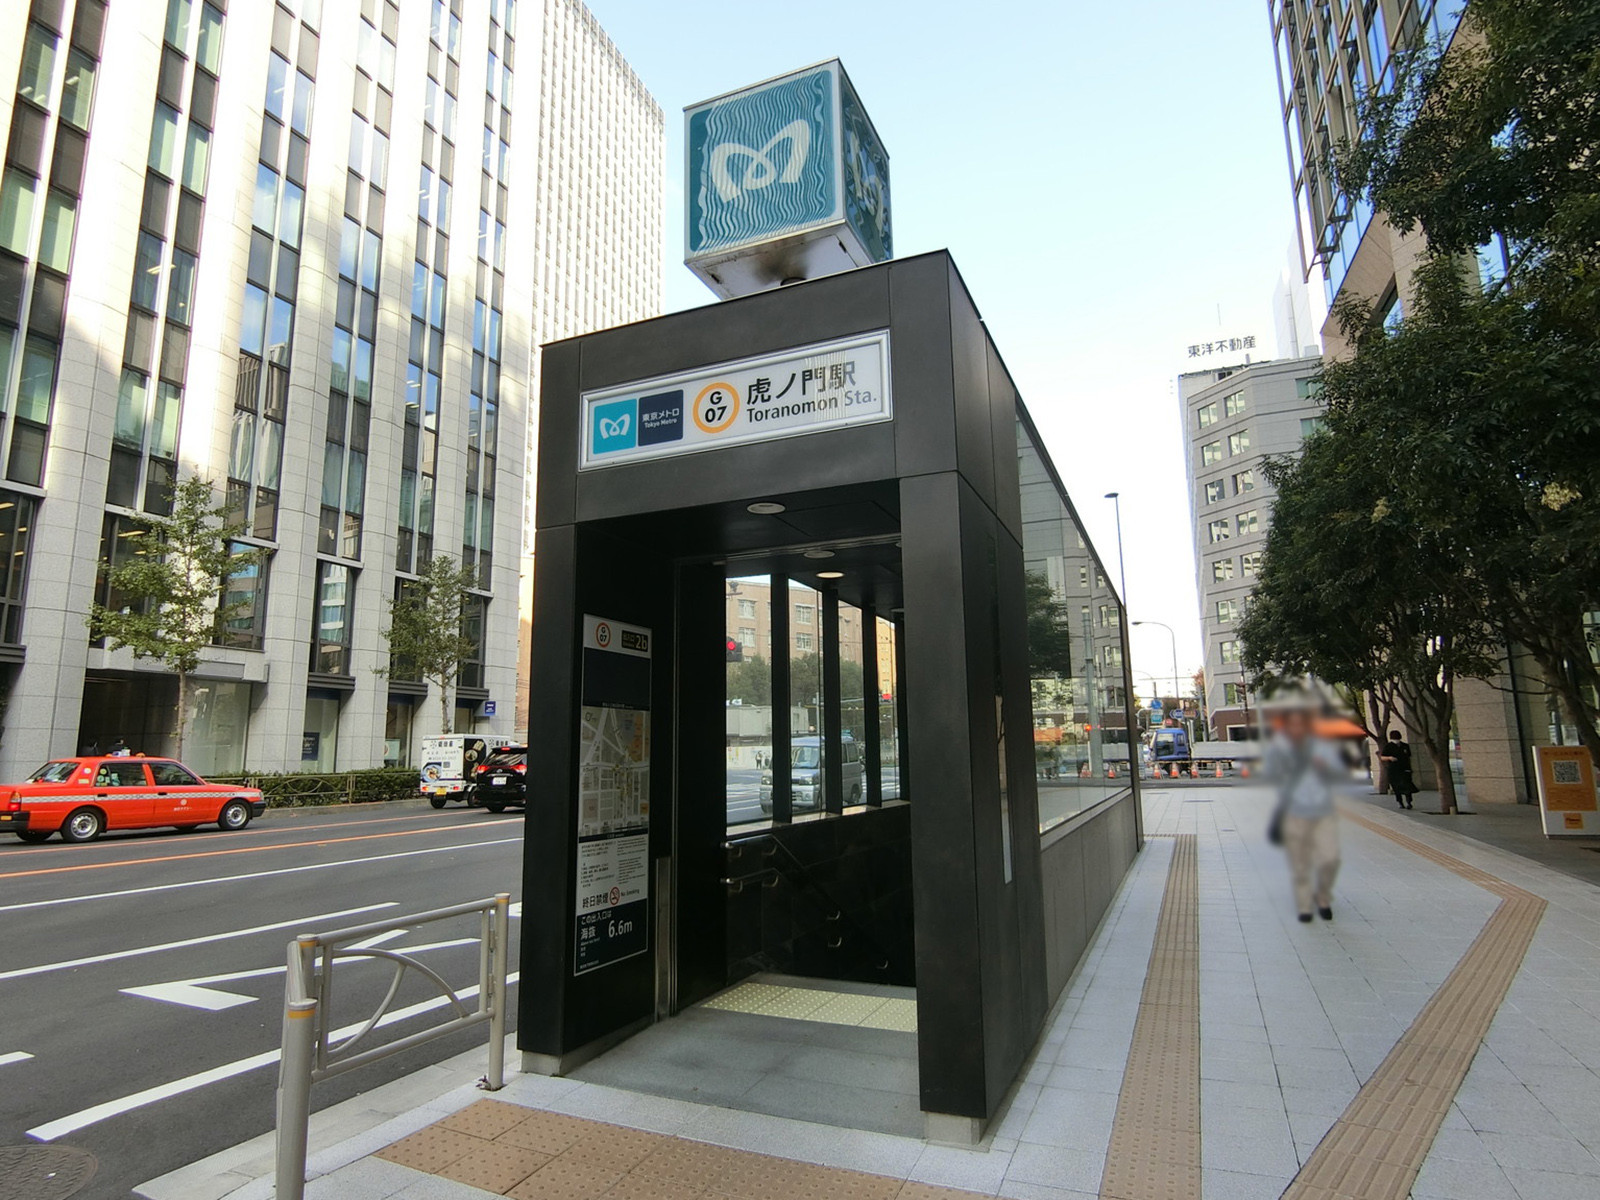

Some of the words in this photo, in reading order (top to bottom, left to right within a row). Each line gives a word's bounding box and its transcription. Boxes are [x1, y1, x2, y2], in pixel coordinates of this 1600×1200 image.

[1188, 335, 1256, 358] 東洋不動産
[747, 360, 857, 405] 虎ノ門駅
[710, 391, 722, 405] G
[747, 396, 838, 423] Toranomon
[844, 390, 877, 406] Sta.
[642, 408, 680, 422] 東京メトロ
[705, 405, 727, 423] 07
[644, 420, 660, 429] Tokyo
[660, 418, 678, 426] Metro
[599, 634, 607, 642] 07
[608, 920, 633, 938] 6.6m
